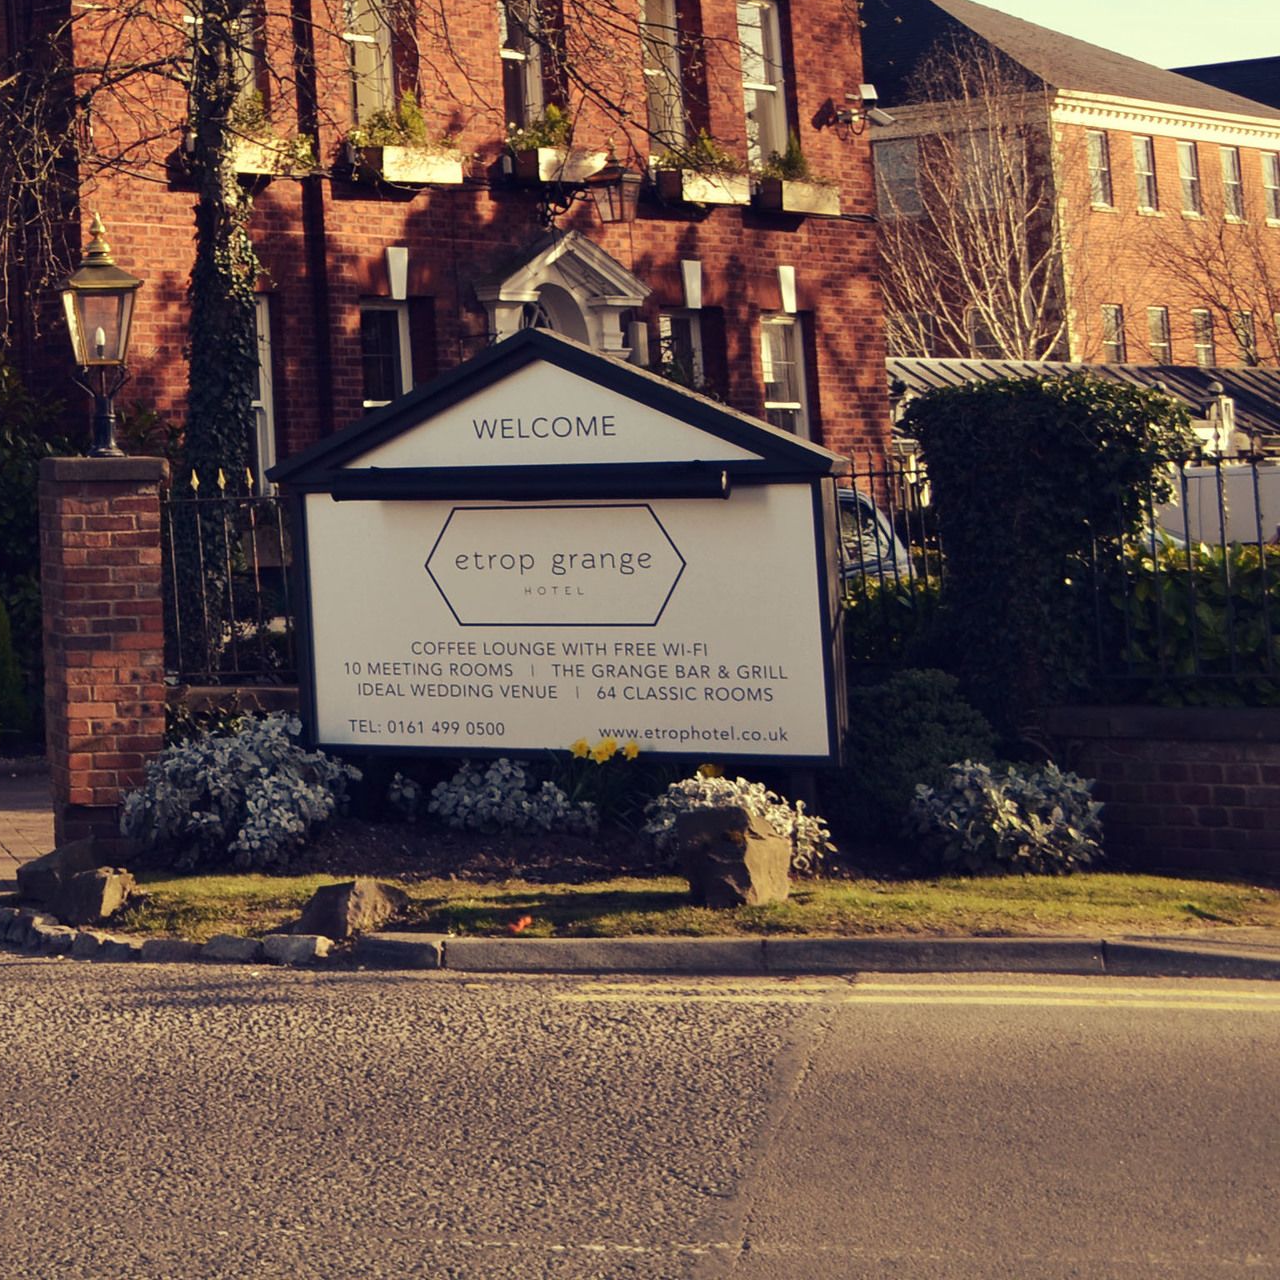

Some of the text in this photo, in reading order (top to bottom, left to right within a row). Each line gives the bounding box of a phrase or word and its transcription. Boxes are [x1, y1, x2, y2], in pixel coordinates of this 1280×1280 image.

[473, 416, 616, 439] WELCOME
[455, 552, 652, 575] etrop grange
[524, 586, 584, 596] HOTEL
[411, 641, 708, 657] COFFEE LOUNGE WITH FREE WI-FI
[344, 662, 361, 675] 10
[367, 662, 442, 676] MEETING
[449, 663, 513, 677] ROOMS
[551, 664, 585, 678] THE
[591, 663, 669, 679] GRANGE
[676, 664, 711, 679] BAR
[718, 664, 730, 679] &
[737, 664, 788, 679] GRILL
[358, 683, 405, 697] IDEAL
[410, 683, 493, 698] WEDDING
[500, 685, 558, 699] VENUE
[597, 686, 616, 700] 64
[623, 686, 697, 701] CLASSIC
[704, 687, 773, 702] ROOMS
[348, 720, 505, 736] TEL: 0161 499 0500
[599, 725, 788, 743] www.etrophotel.co.uk
